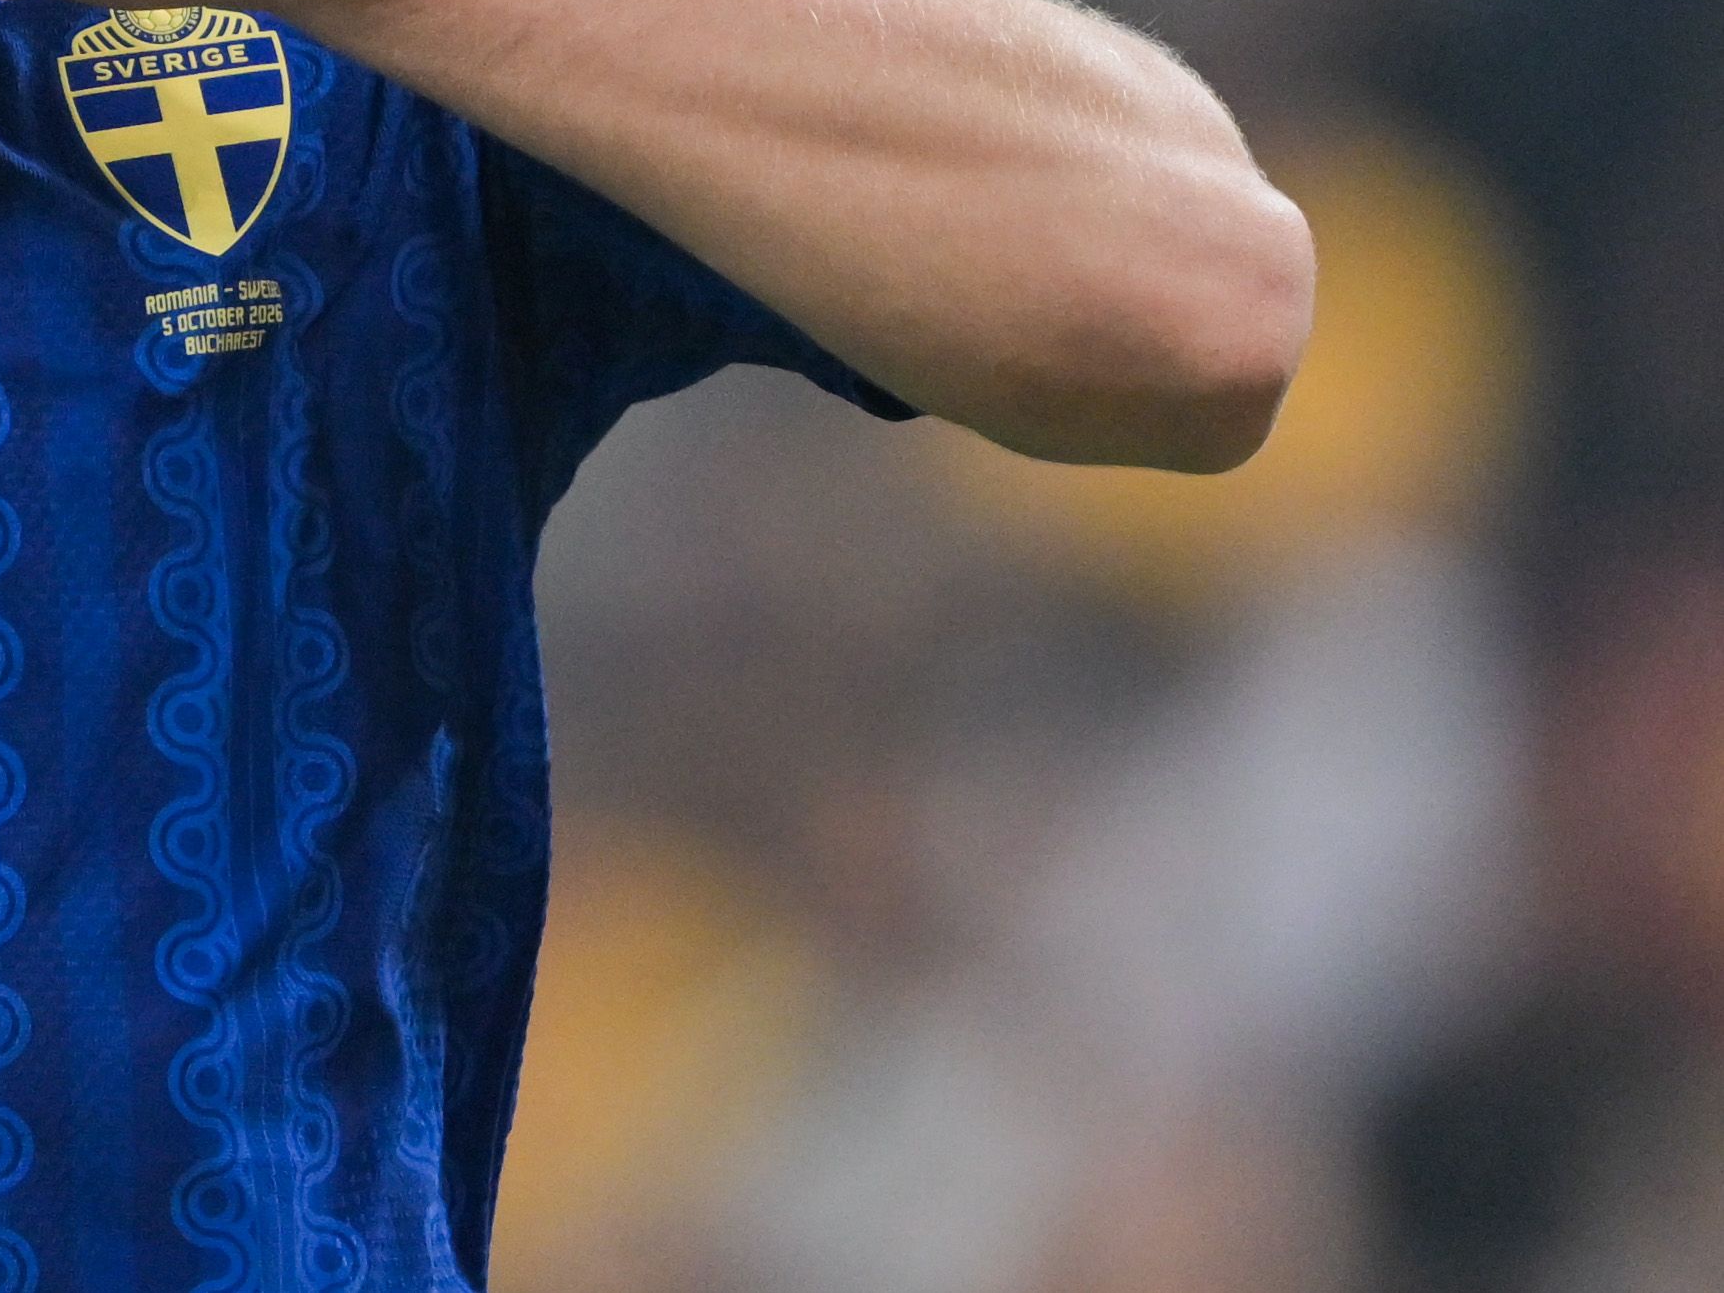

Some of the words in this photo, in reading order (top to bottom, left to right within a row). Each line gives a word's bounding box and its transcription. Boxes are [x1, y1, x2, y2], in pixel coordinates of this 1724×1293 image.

[93, 43, 249, 82] SVERIGE
[145, 283, 219, 315] ROMANIA
[162, 316, 173, 336] 5
[177, 307, 245, 333] OCTOBER
[249, 303, 283, 324] 2026
[185, 329, 266, 356] BUCHAREST
